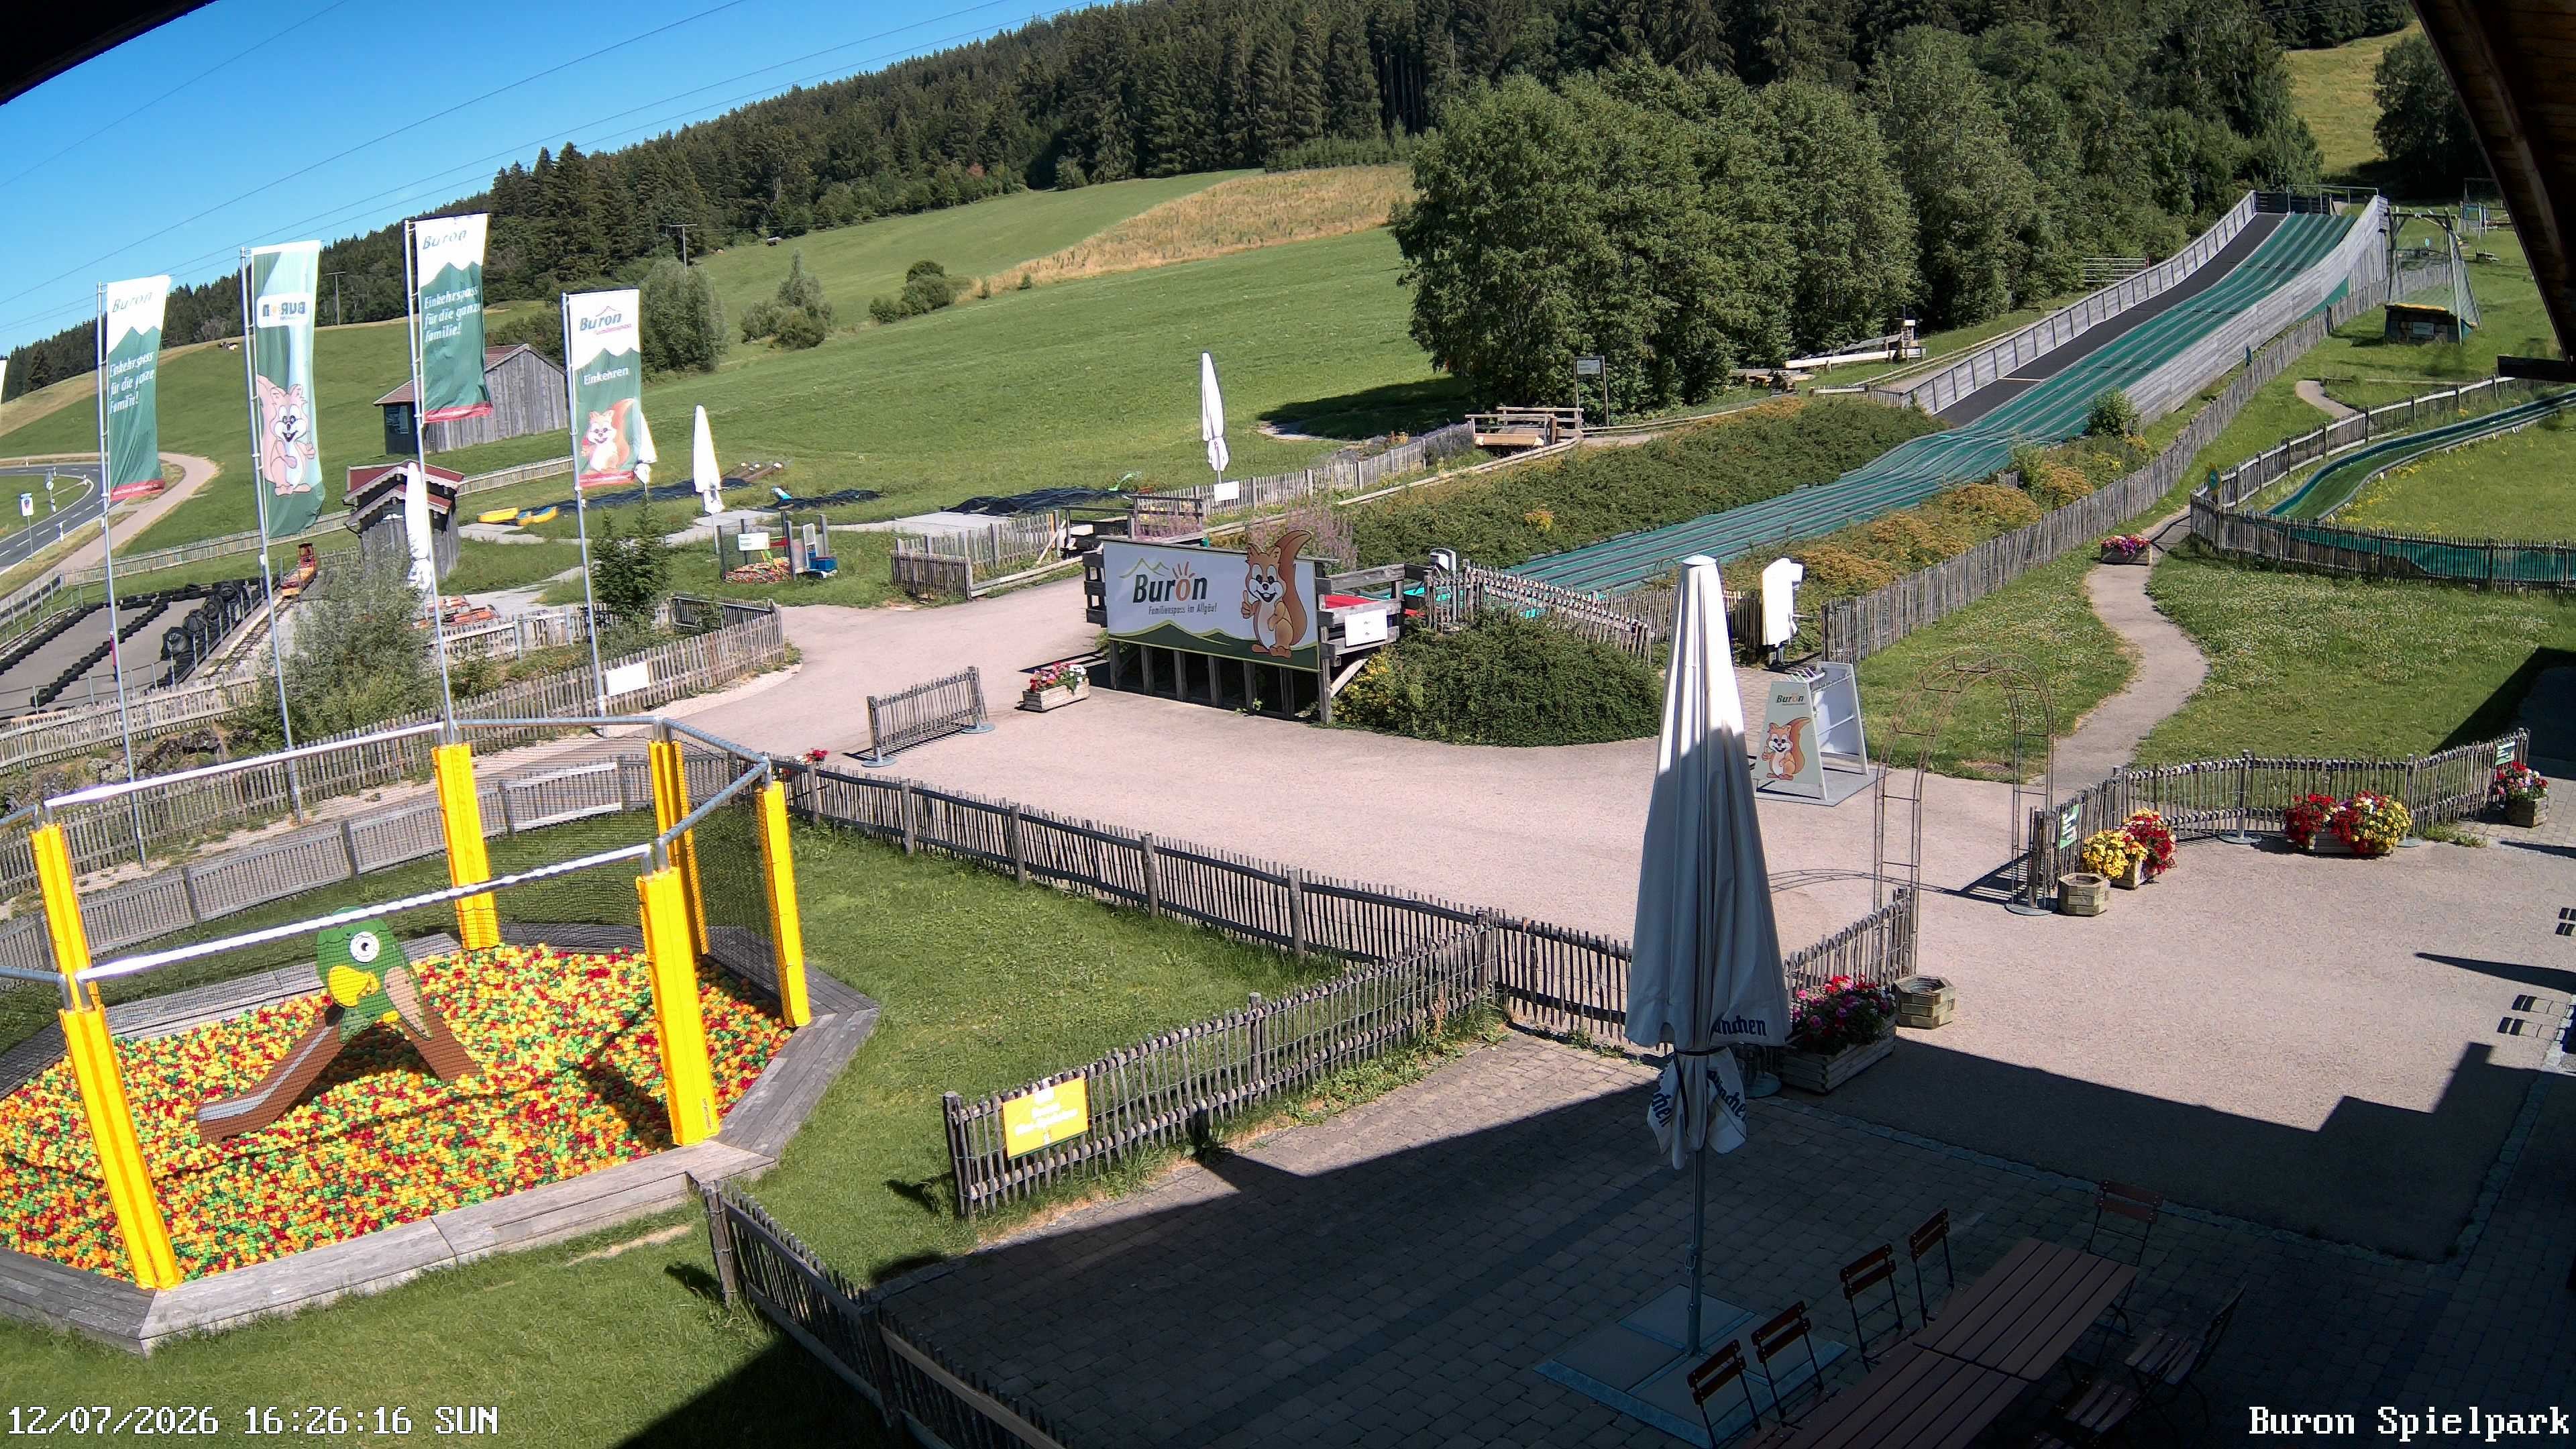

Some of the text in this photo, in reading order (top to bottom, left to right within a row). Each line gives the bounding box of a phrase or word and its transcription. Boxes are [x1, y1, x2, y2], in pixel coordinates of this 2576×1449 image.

[439, 308, 454, 322] die
[580, 313, 623, 331] Buron
[1133, 574, 1208, 602] Buron
[1187, 604, 1195, 612] im
[1776, 694, 1804, 704] Buron
